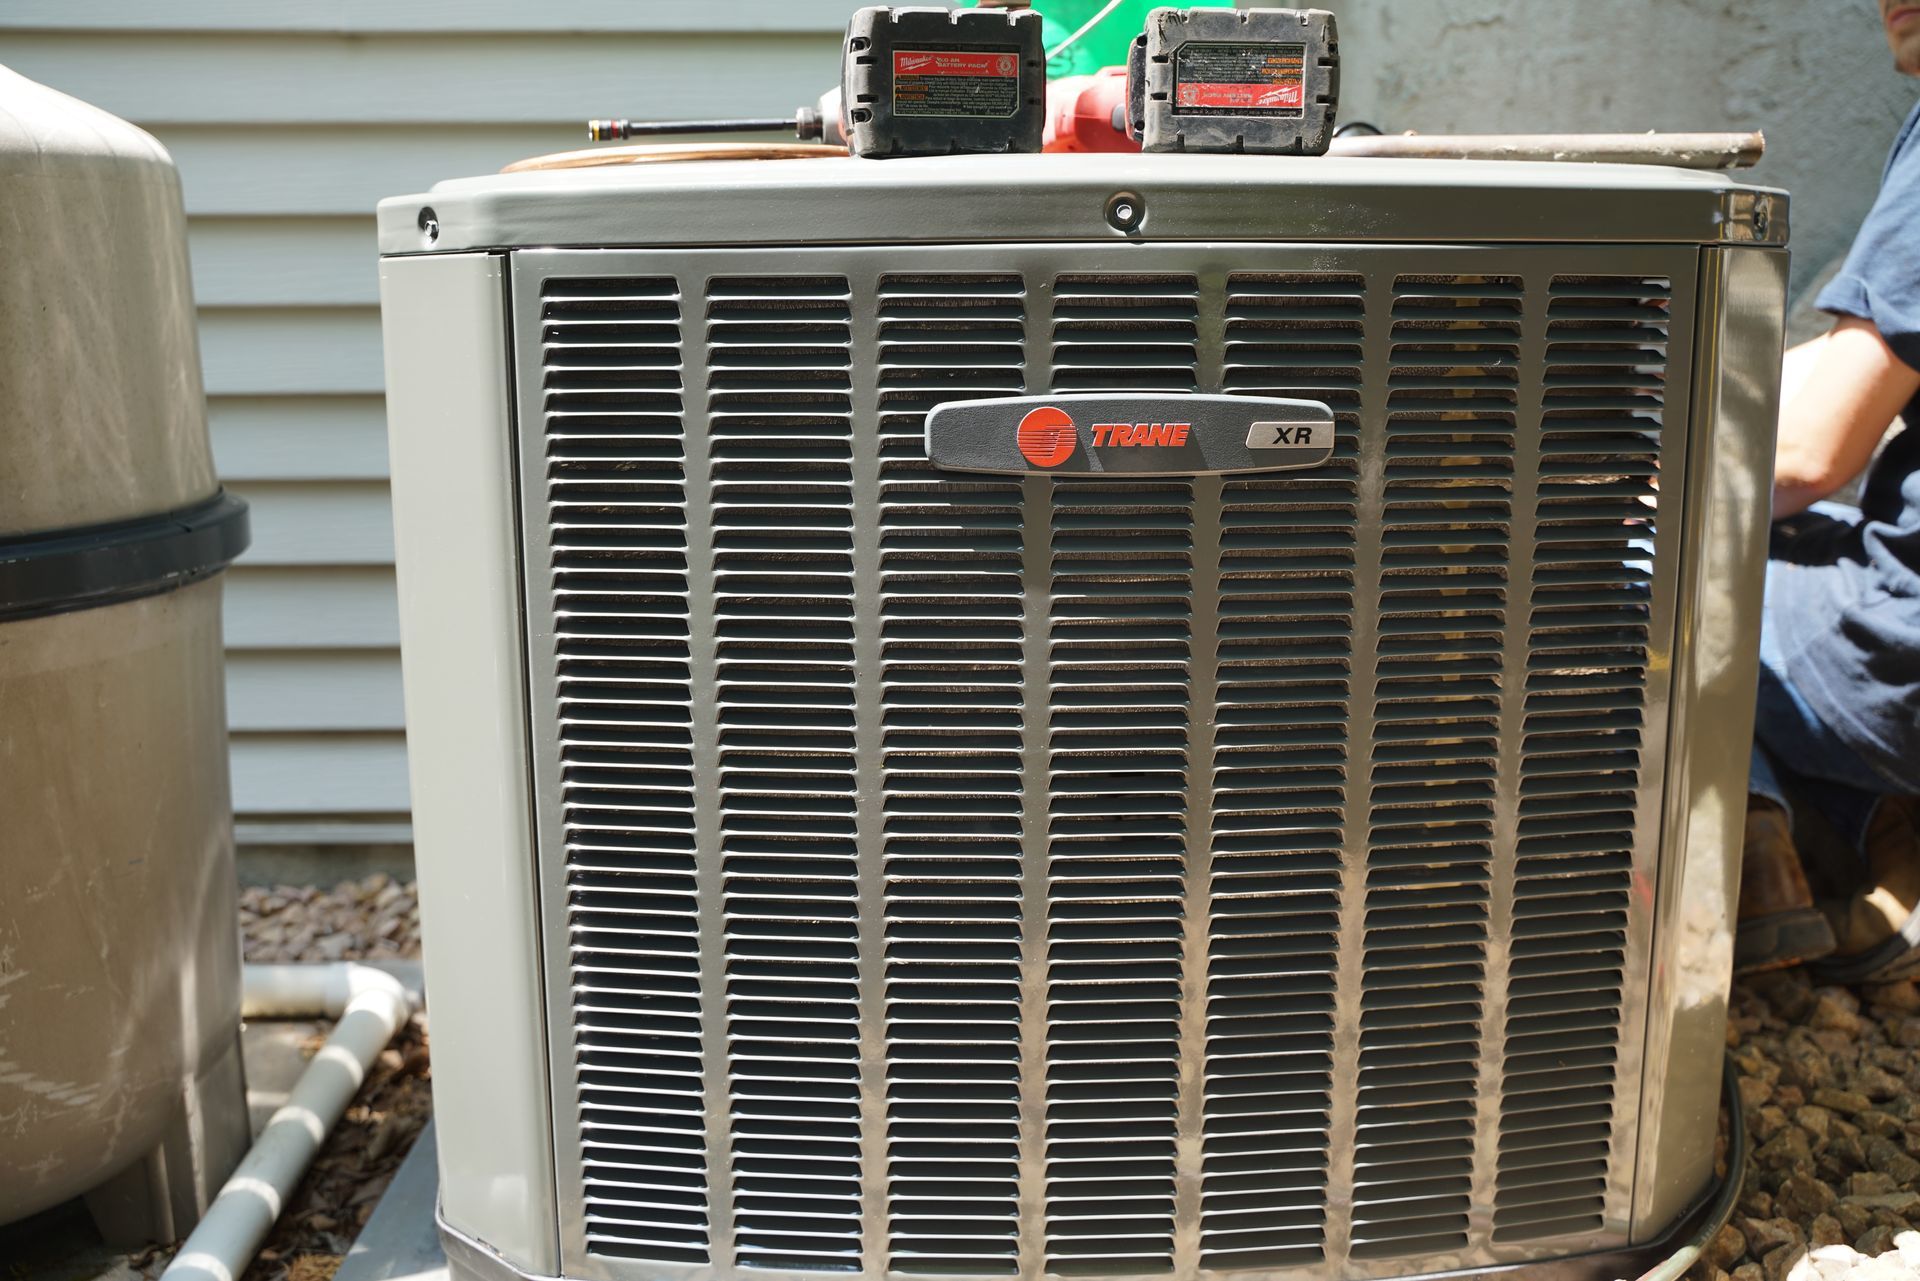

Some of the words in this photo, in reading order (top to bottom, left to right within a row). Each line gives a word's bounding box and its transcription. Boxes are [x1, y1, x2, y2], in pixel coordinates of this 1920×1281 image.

[900, 55, 933, 67] Milwaukee
[1256, 90, 1299, 106] Milwaukee
[1091, 423, 1191, 447] TRANE
[1272, 427, 1312, 444] XR
